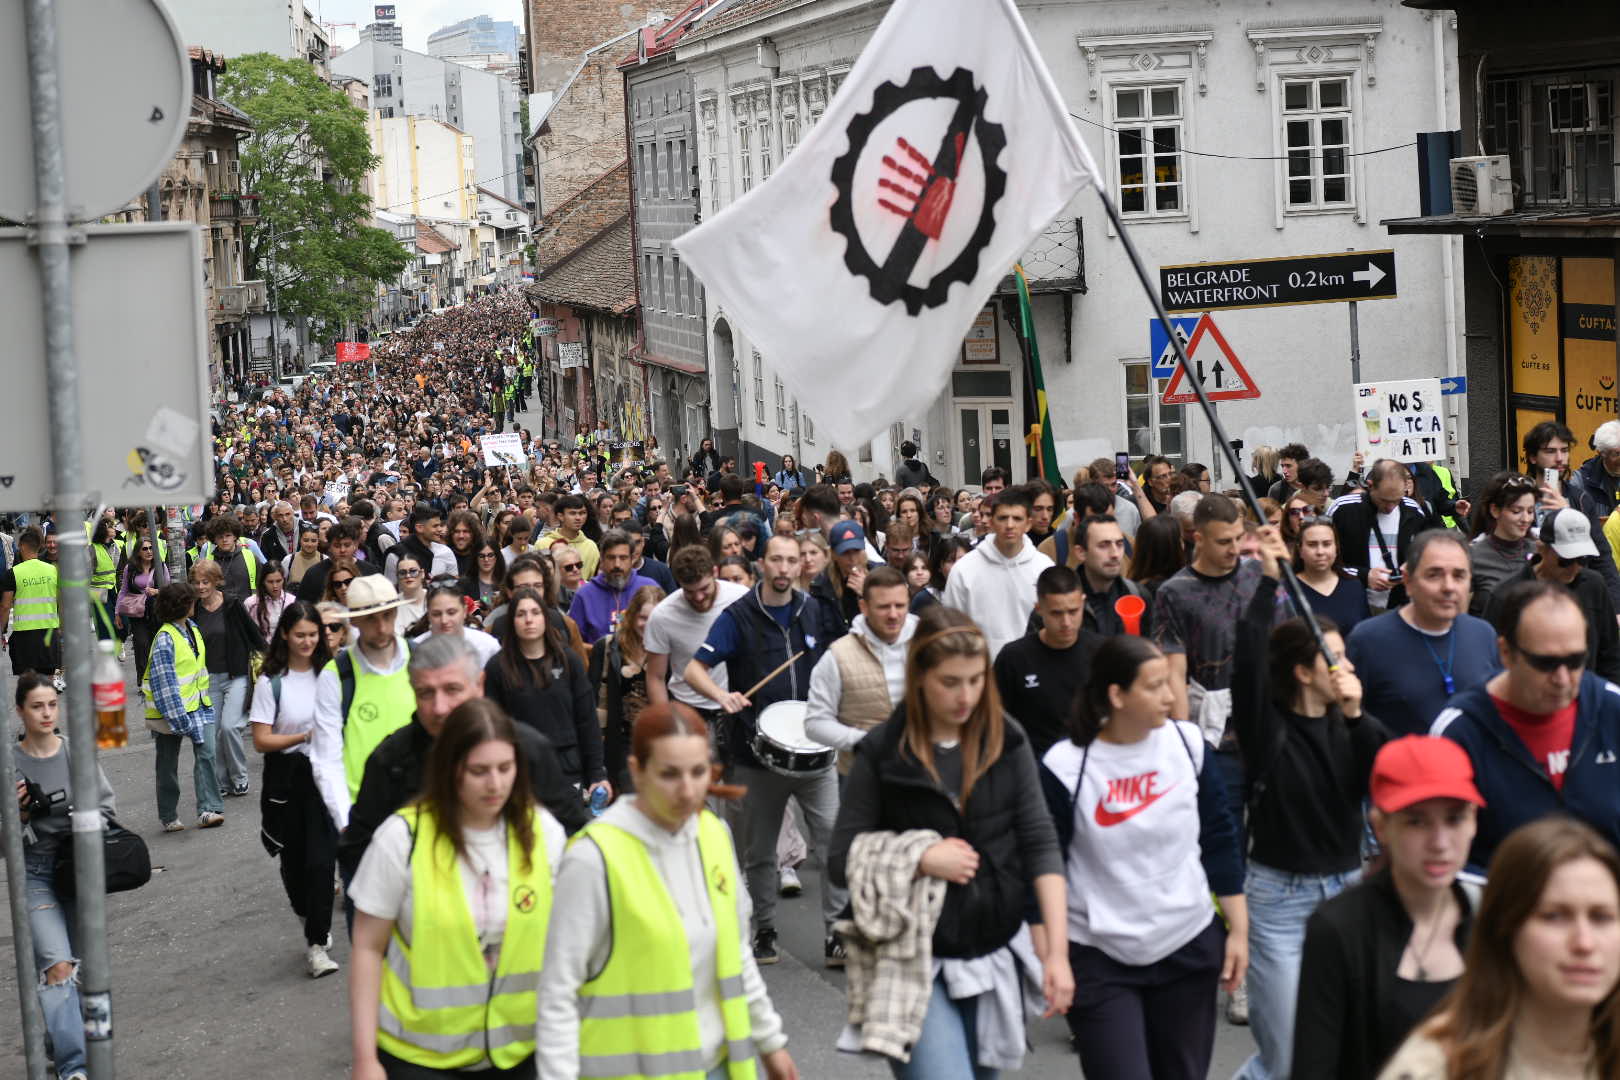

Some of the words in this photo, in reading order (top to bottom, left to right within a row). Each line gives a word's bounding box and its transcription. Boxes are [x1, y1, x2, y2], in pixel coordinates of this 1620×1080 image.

[1167, 268, 1251, 288] BELGRADE
[1168, 284, 1281, 305] WATERFRONT
[1106, 770, 1161, 804] NIKE
